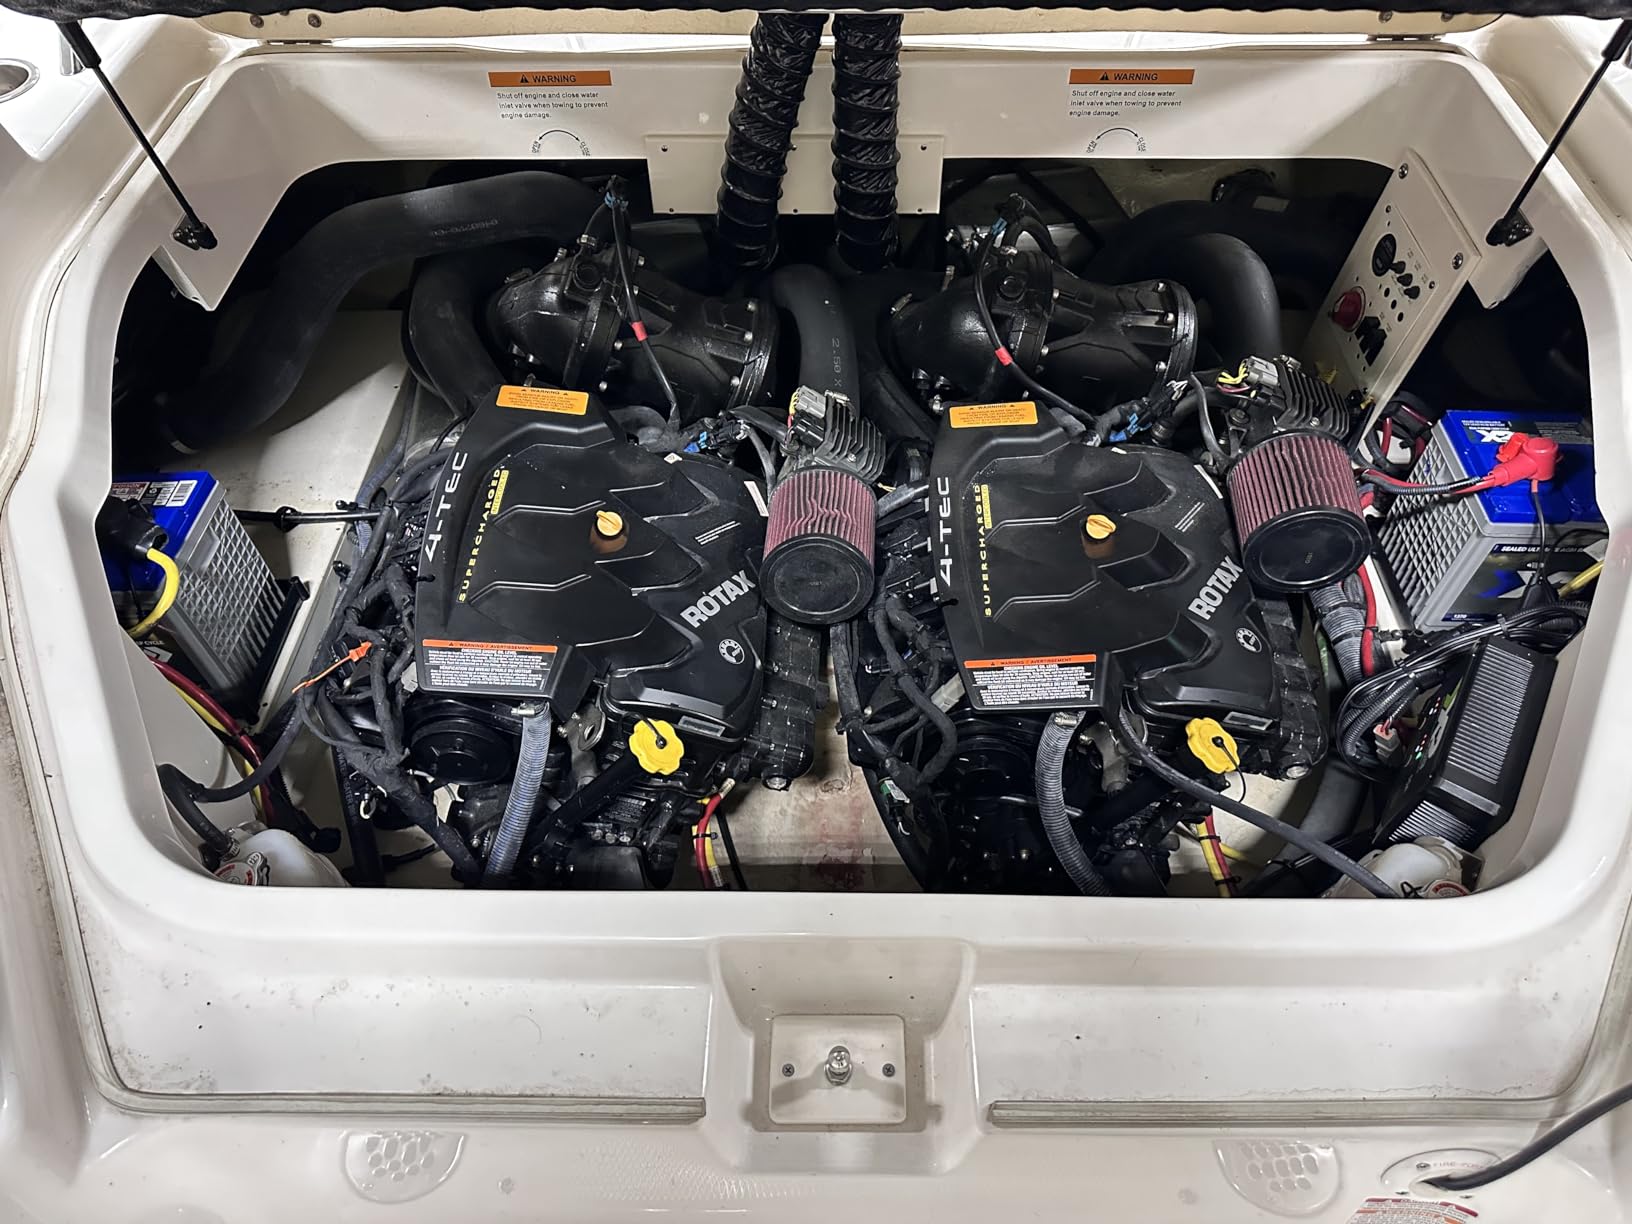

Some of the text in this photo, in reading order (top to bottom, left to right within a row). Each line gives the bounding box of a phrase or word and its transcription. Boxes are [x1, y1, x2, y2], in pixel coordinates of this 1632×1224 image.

[532, 75, 576, 83] WARNING
[425, 452, 468, 562] 4-TEC
[458, 469, 500, 602] SUPERCHARGED
[937, 477, 953, 587] 4-TEC
[974, 484, 992, 617] SUPERCHARGED
[680, 570, 756, 628] ROTAX
[1188, 555, 1244, 620] ROTAX
